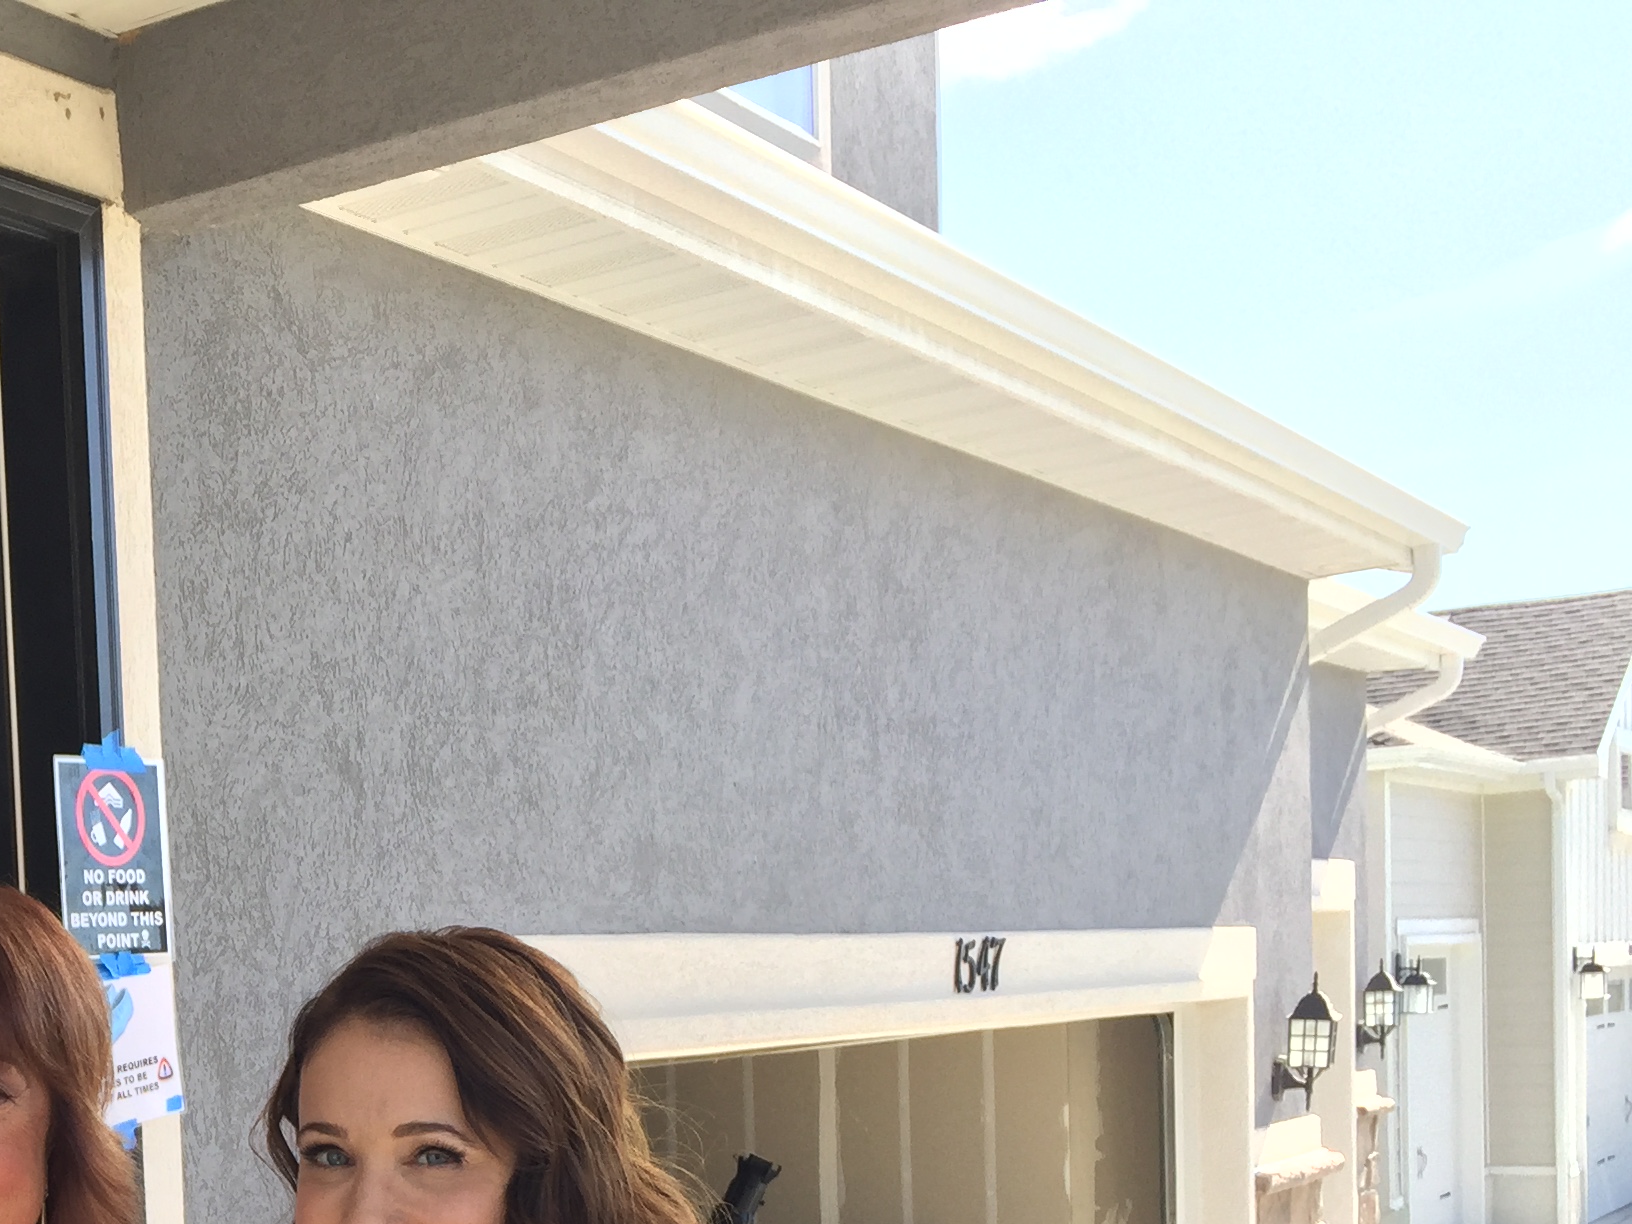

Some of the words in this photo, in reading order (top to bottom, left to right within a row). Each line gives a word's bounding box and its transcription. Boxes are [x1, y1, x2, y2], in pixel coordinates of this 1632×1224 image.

[83, 868, 103, 884] NO
[108, 868, 145, 884] FOOD
[81, 890, 102, 906] OR
[105, 889, 149, 905] DRINK
[70, 911, 127, 927] BEYOND
[130, 910, 163, 926] THIS
[97, 932, 139, 948] POINT
[953, 935, 1006, 993] 1547
[116, 1055, 158, 1073] REQUIRES
[123, 1074, 134, 1084] TO
[136, 1071, 147, 1081] BE
[116, 1089, 132, 1099] ALL
[134, 1081, 159, 1095] TIMES
